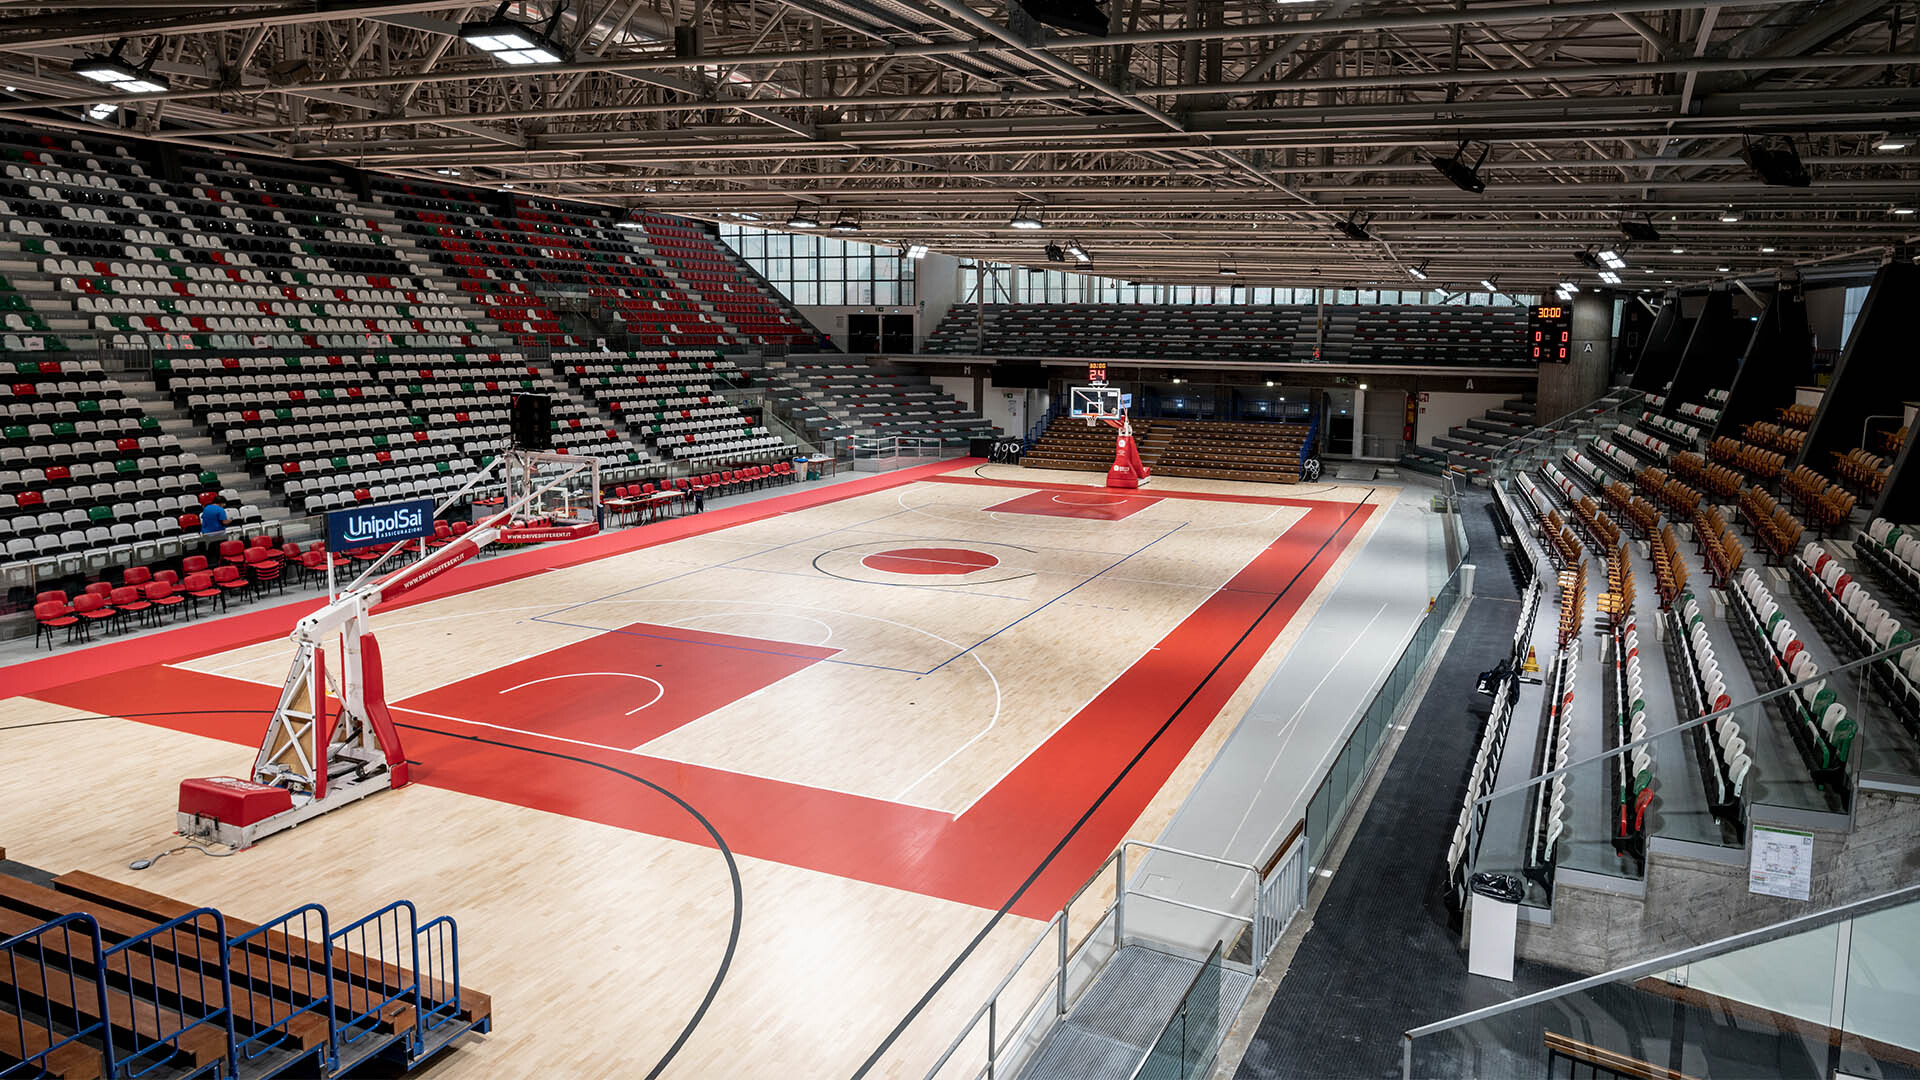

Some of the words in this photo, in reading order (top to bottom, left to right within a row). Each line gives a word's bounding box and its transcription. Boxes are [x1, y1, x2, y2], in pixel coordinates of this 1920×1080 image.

[1537, 307, 1561, 318] 30:00
[1535, 331, 1542, 342] 0
[1561, 331, 1568, 342] 0
[1533, 347, 1540, 357] 0
[1559, 347, 1566, 358] 0
[1583, 343, 1593, 353] A
[1089, 369, 1106, 381] 24
[1466, 379, 1474, 389] A
[348, 508, 422, 539] UnipolSai
[380, 526, 423, 538] ASSICURAZIONI
[507, 531, 571, 540] WWW.DRIVEDIFFERENT.IT
[404, 553, 465, 589] WWW.DRIVEDIFFERENT.IT
